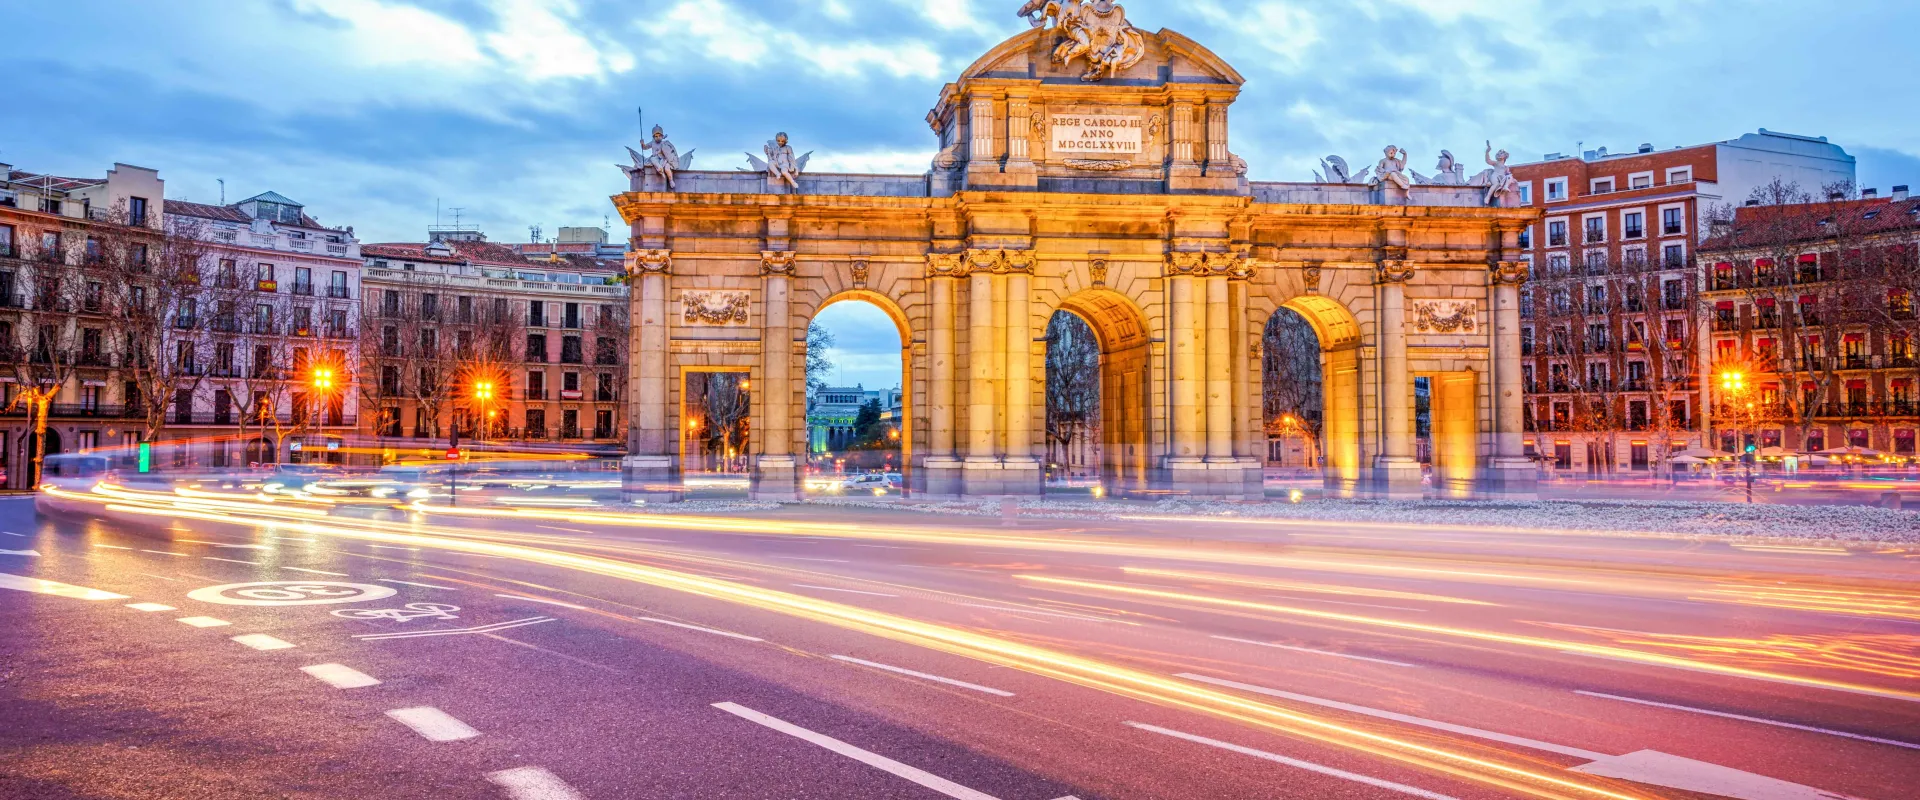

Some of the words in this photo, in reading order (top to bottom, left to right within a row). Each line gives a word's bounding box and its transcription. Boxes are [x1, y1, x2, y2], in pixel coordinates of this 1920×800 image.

[1052, 117, 1080, 126] REGE
[1084, 118, 1127, 127] CAROLO
[1130, 119, 1142, 128] III
[1081, 129, 1114, 138] ANNO
[1058, 140, 1136, 150] MDCCLXXVIII
